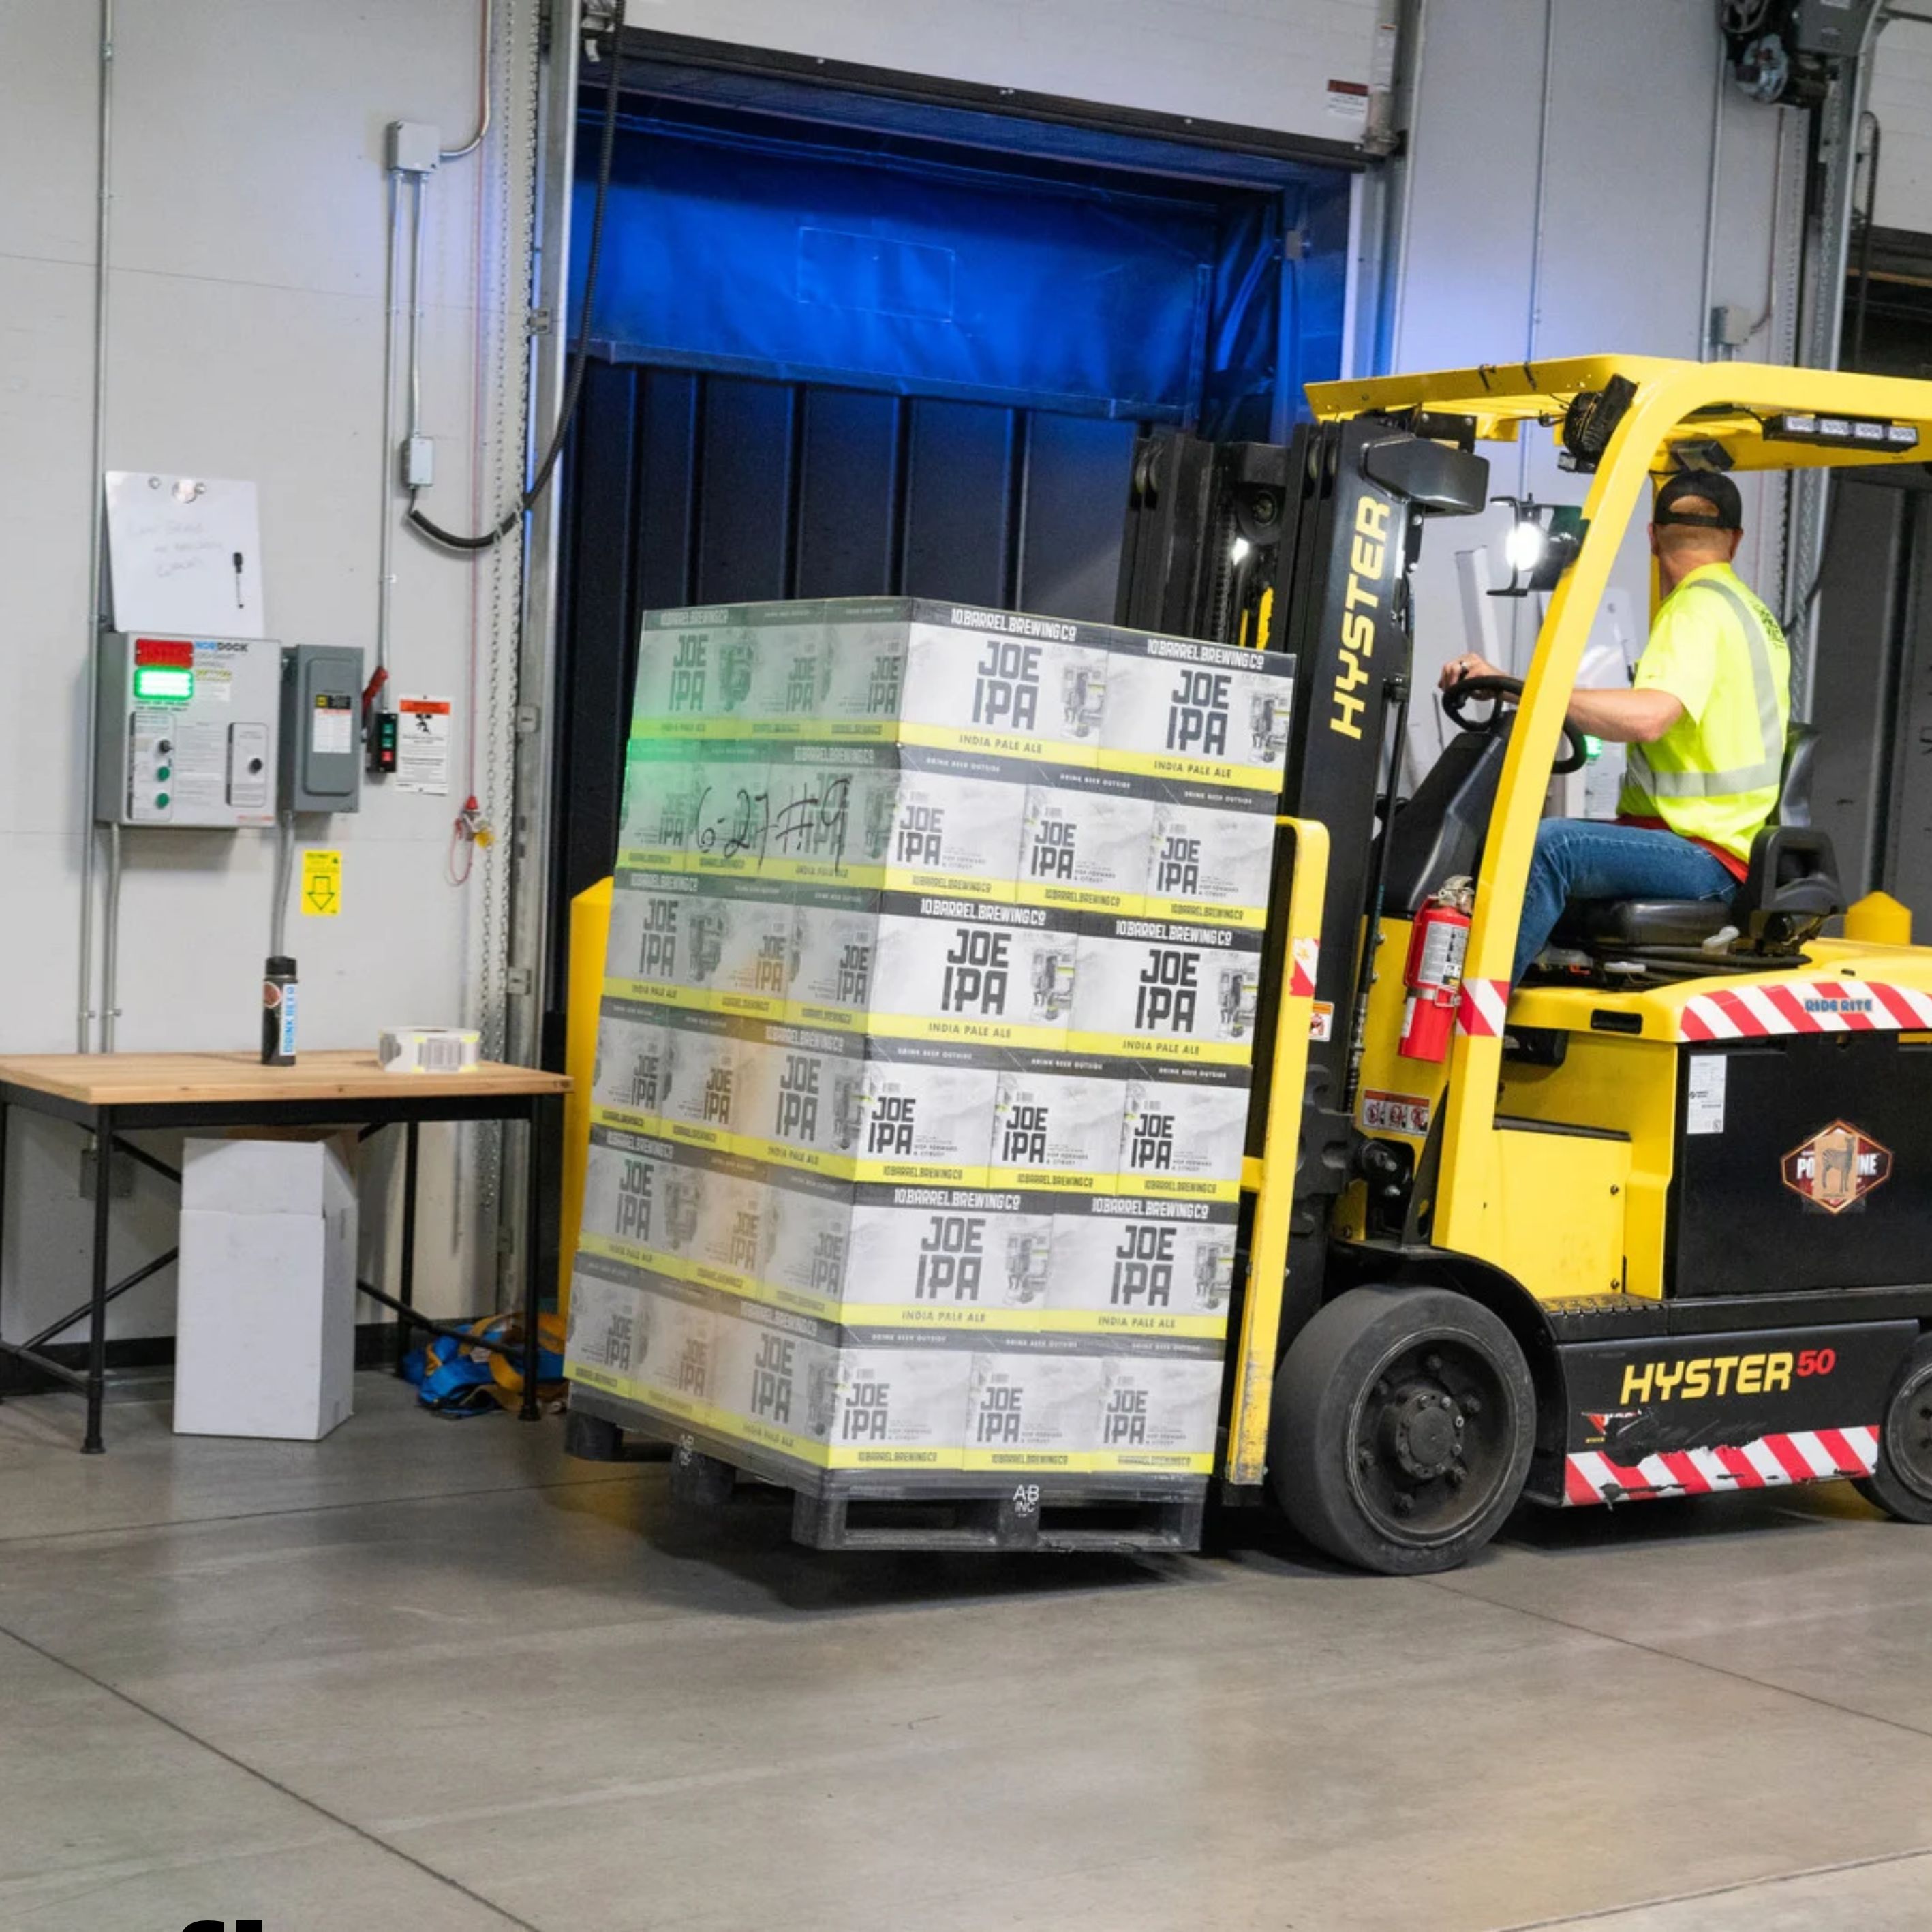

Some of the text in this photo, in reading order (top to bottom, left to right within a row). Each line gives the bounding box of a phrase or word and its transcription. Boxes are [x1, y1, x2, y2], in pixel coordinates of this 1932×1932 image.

[1330, 495, 1390, 740] HYSTER
[674, 634, 708, 668] JOE
[978, 641, 1042, 682] JOE
[788, 657, 816, 681] JOE
[872, 656, 900, 680] JOE
[669, 670, 706, 711] IPA
[786, 681, 814, 710] IPA
[867, 684, 898, 714] IPA
[972, 678, 1039, 730] IPA
[1171, 669, 1232, 709] JOE
[959, 735, 1042, 754] INDIA PALE ALE
[1166, 706, 1228, 755] IPA
[1154, 761, 1232, 779] INDIA PALE ALE
[900, 806, 945, 833] JOE
[1034, 821, 1077, 847] JOE
[897, 831, 942, 865] IPA
[1031, 846, 1074, 880] IPA
[1160, 836, 1201, 863] JOE
[1156, 862, 1199, 895] IPA
[644, 899, 679, 932] JOE
[639, 934, 676, 977] IPA
[758, 936, 786, 960] JOE
[840, 945, 870, 970] JOE
[947, 929, 1012, 968] JOE
[755, 962, 784, 992] IPA
[1140, 949, 1200, 987] JOE
[837, 970, 868, 1005] IPA
[941, 967, 1007, 1015] IPA
[1135, 986, 1197, 1032] IPA
[1805, 998, 1873, 1013] RIDE RITE
[928, 1023, 1011, 1038] INDIA PALE ALE
[1122, 1040, 1199, 1055] INDIA PALE ALE
[634, 1056, 660, 1079] JOE
[706, 1069, 733, 1093] JOE
[780, 1056, 821, 1094] JOE
[631, 1079, 657, 1109] IPA
[703, 1094, 731, 1124] IPA
[872, 1097, 916, 1122] JOE
[776, 1092, 818, 1141] IPA
[1005, 1106, 1048, 1131] JOE
[1134, 1114, 1175, 1138] JOE
[868, 1122, 914, 1154] IPA
[1002, 1131, 1046, 1163] IPA
[1131, 1139, 1172, 1169] IPA
[620, 1159, 654, 1197] JOE
[615, 1194, 652, 1242] IPA
[816, 1231, 843, 1261] JOE
[921, 1216, 986, 1253] JOE
[1116, 1226, 1177, 1261] JOE
[811, 1258, 840, 1293] IPA
[915, 1255, 981, 1300] IPA
[1110, 1262, 1173, 1306] IPA
[902, 1310, 985, 1323] INDIA PALE ALE
[1099, 1315, 1175, 1328] INDIA PALE ALE
[756, 1334, 795, 1377] JOE
[1619, 1348, 1836, 1405] HYSTER 50
[751, 1368, 791, 1424] IPA
[846, 1383, 890, 1407] JOE
[980, 1387, 1023, 1411] JOE
[1107, 1390, 1148, 1413] JOE
[842, 1409, 887, 1440] IPA
[977, 1413, 1021, 1442] IPA
[1103, 1414, 1146, 1444] IPA
